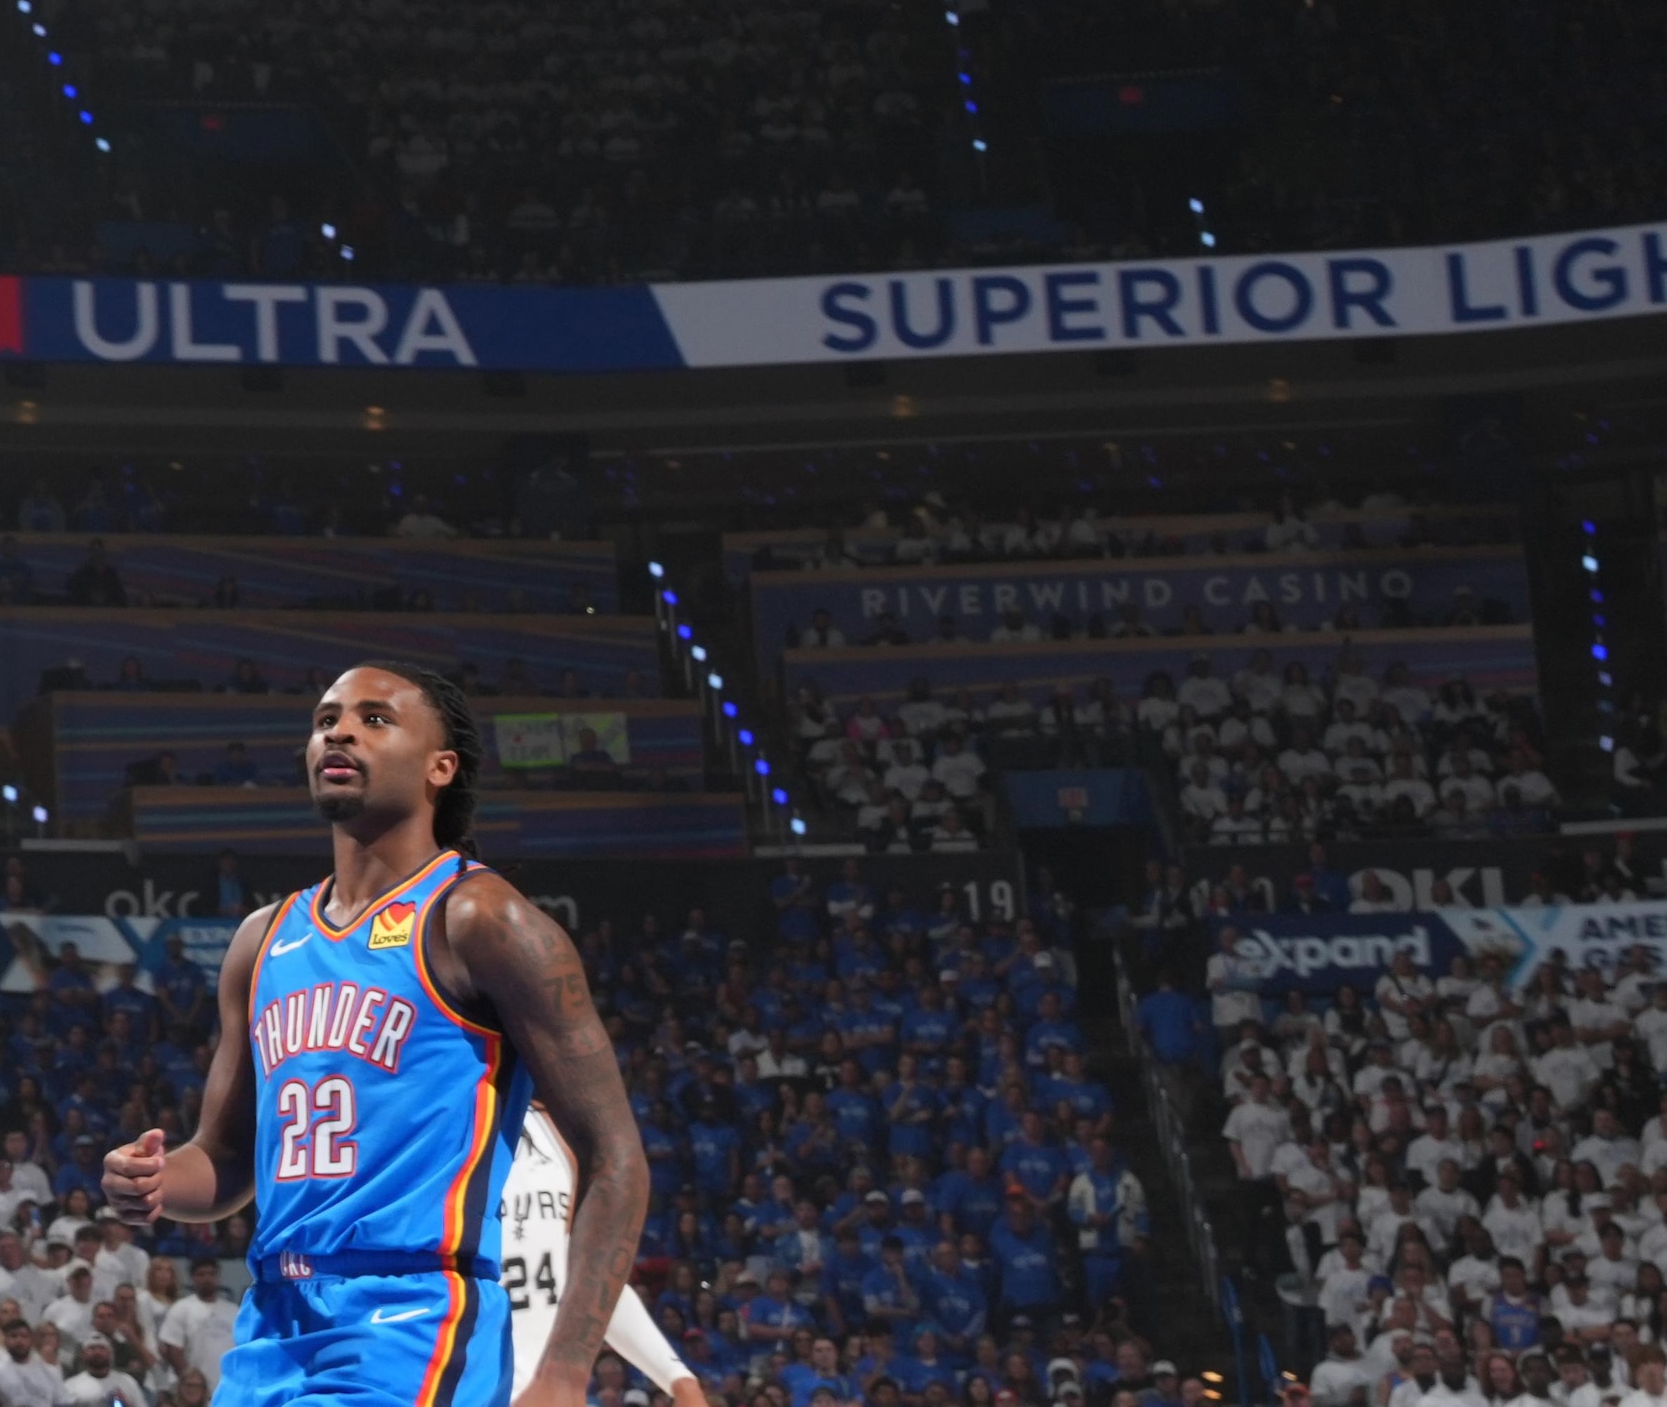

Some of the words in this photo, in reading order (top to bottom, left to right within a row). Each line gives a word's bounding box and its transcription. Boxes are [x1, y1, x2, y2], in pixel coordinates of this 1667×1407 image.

[71, 280, 480, 368] ULTRA
[821, 257, 1398, 354] SUPERIOR
[860, 577, 1173, 619] RIVERWIND
[1203, 568, 1416, 608] CASINO
[1235, 921, 1433, 979] expand
[254, 981, 419, 1079] THUNDER
[275, 1074, 359, 1183] 22
[502, 1250, 559, 1311] 24
